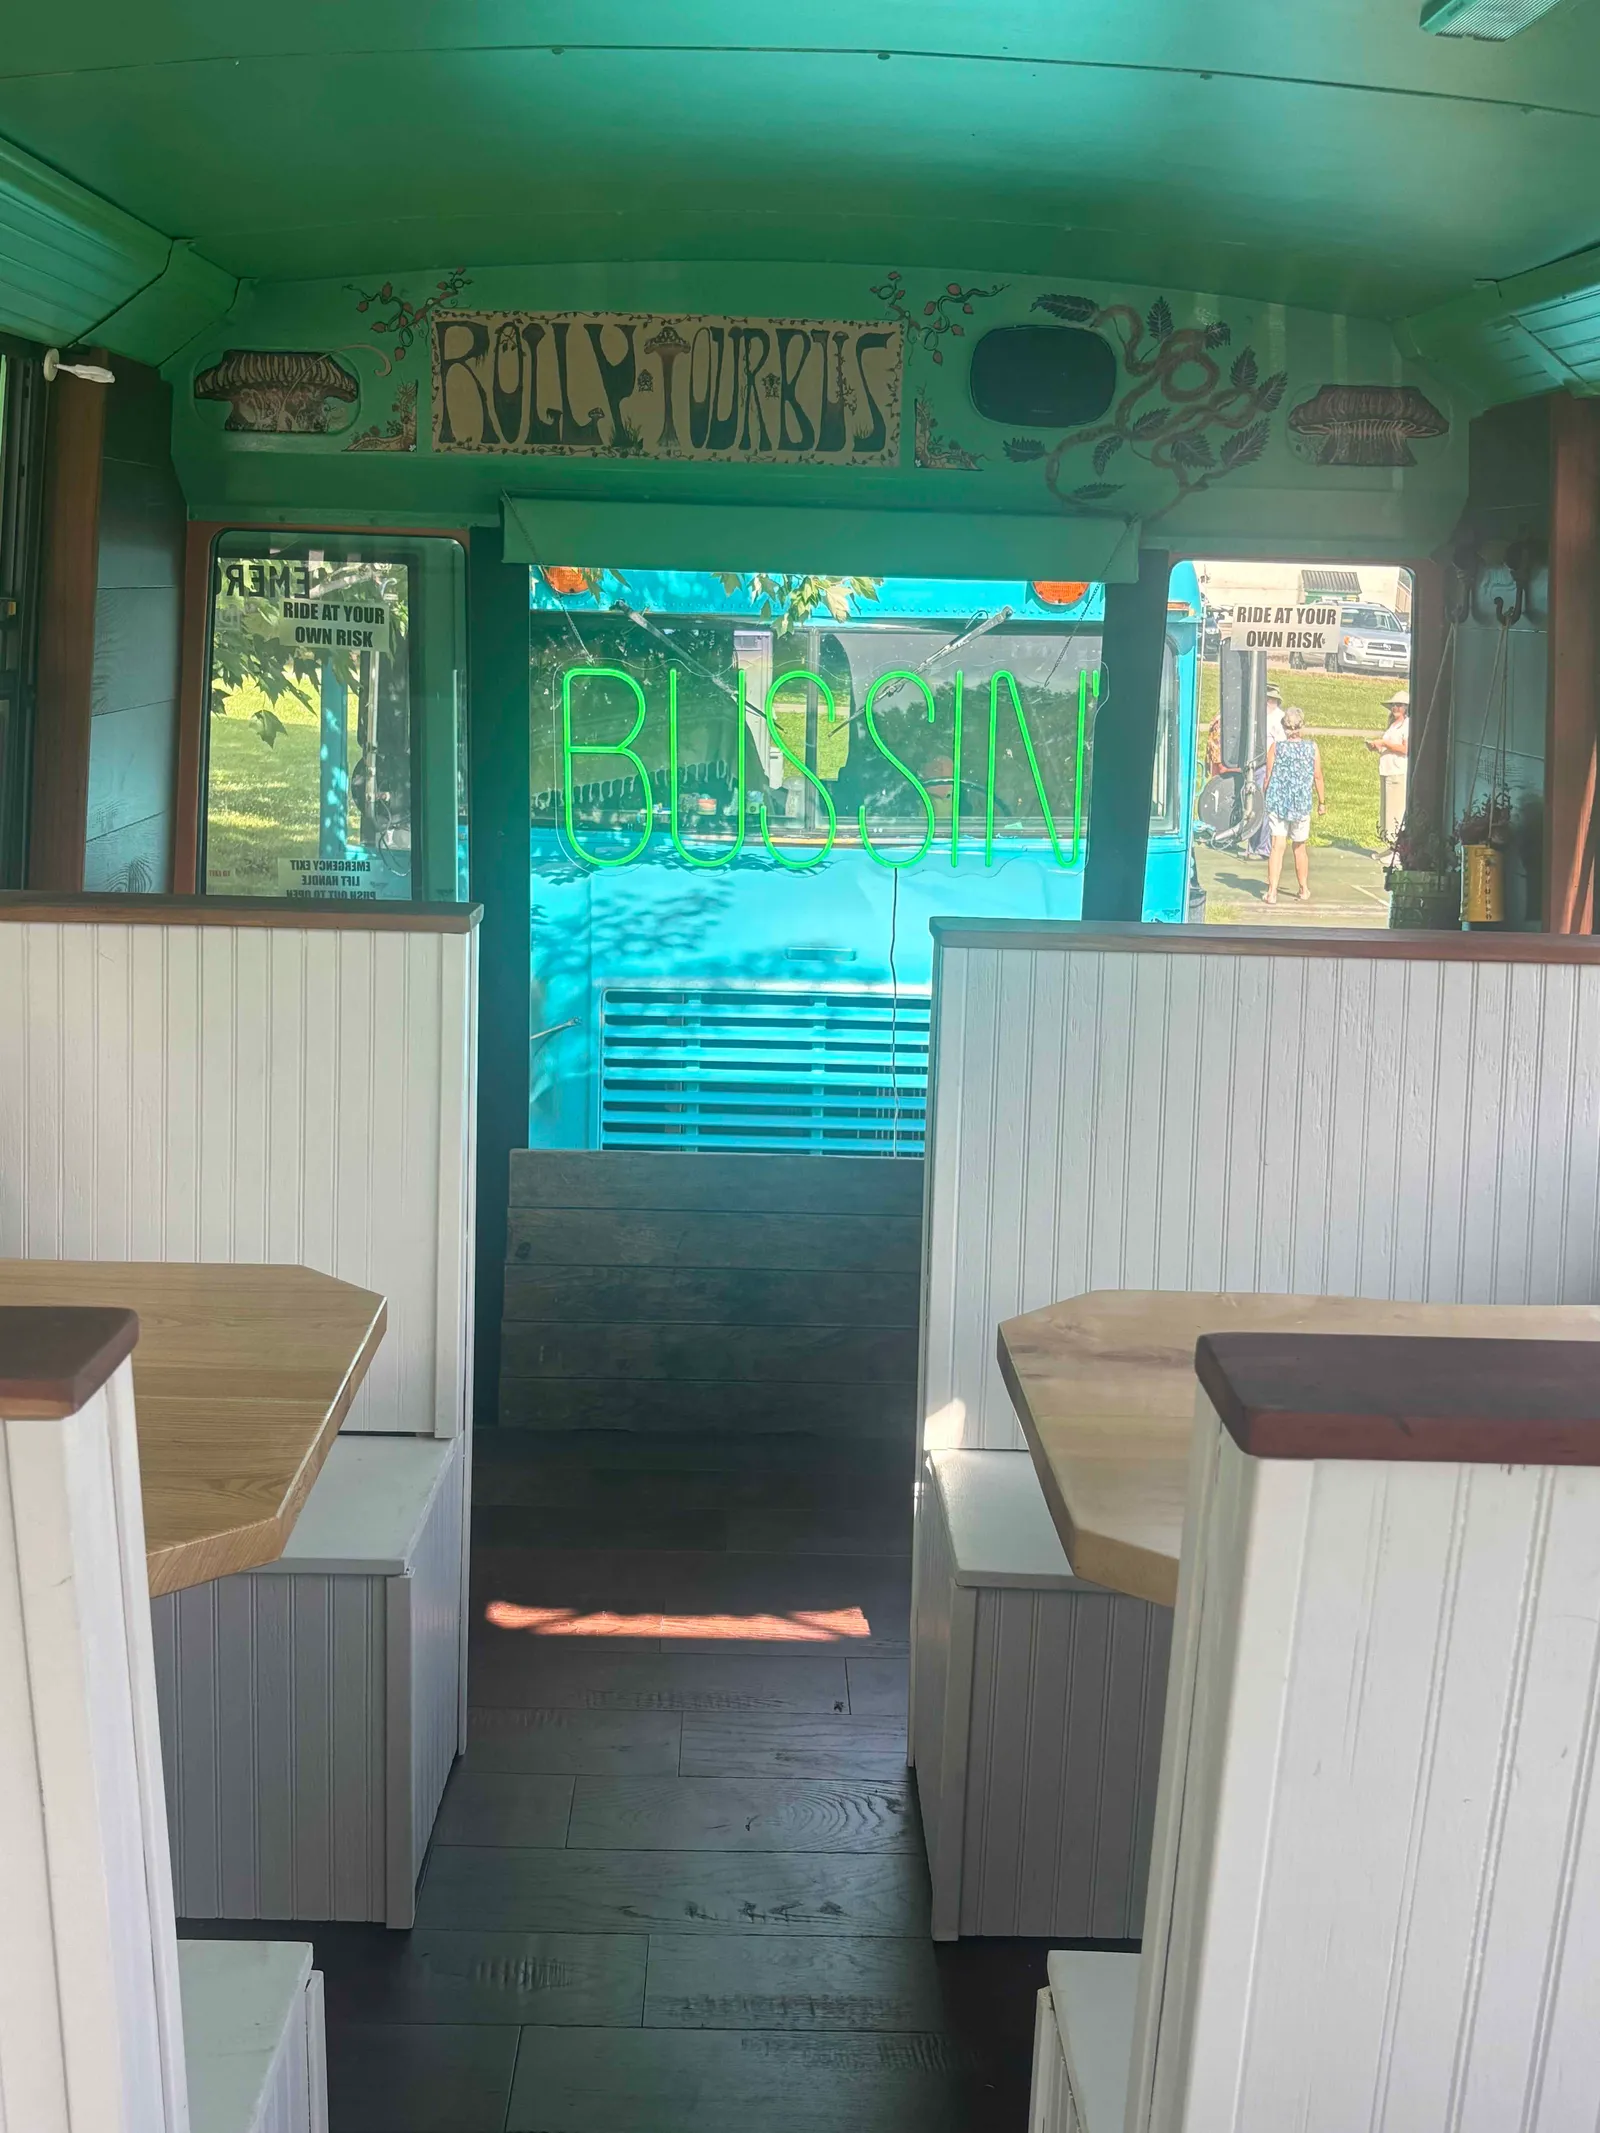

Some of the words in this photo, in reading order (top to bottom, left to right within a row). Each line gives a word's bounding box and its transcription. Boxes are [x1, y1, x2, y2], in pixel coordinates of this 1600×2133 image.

[437, 320, 637, 448] ROLLY
[644, 325, 771, 451] TOUR
[775, 327, 896, 452] BUS
[283, 601, 319, 620] RIDE
[321, 604, 341, 622] AT
[343, 605, 385, 624] YOUR
[1236, 606, 1272, 624] RIDE
[1274, 607, 1293, 624] AT
[1296, 608, 1337, 625] YOUR
[295, 626, 333, 645] OWN
[335, 628, 373, 648] RISK
[1246, 630, 1283, 648] OWN
[1286, 631, 1324, 649] RISK
[563, 668, 1099, 868] BUSSIN'
